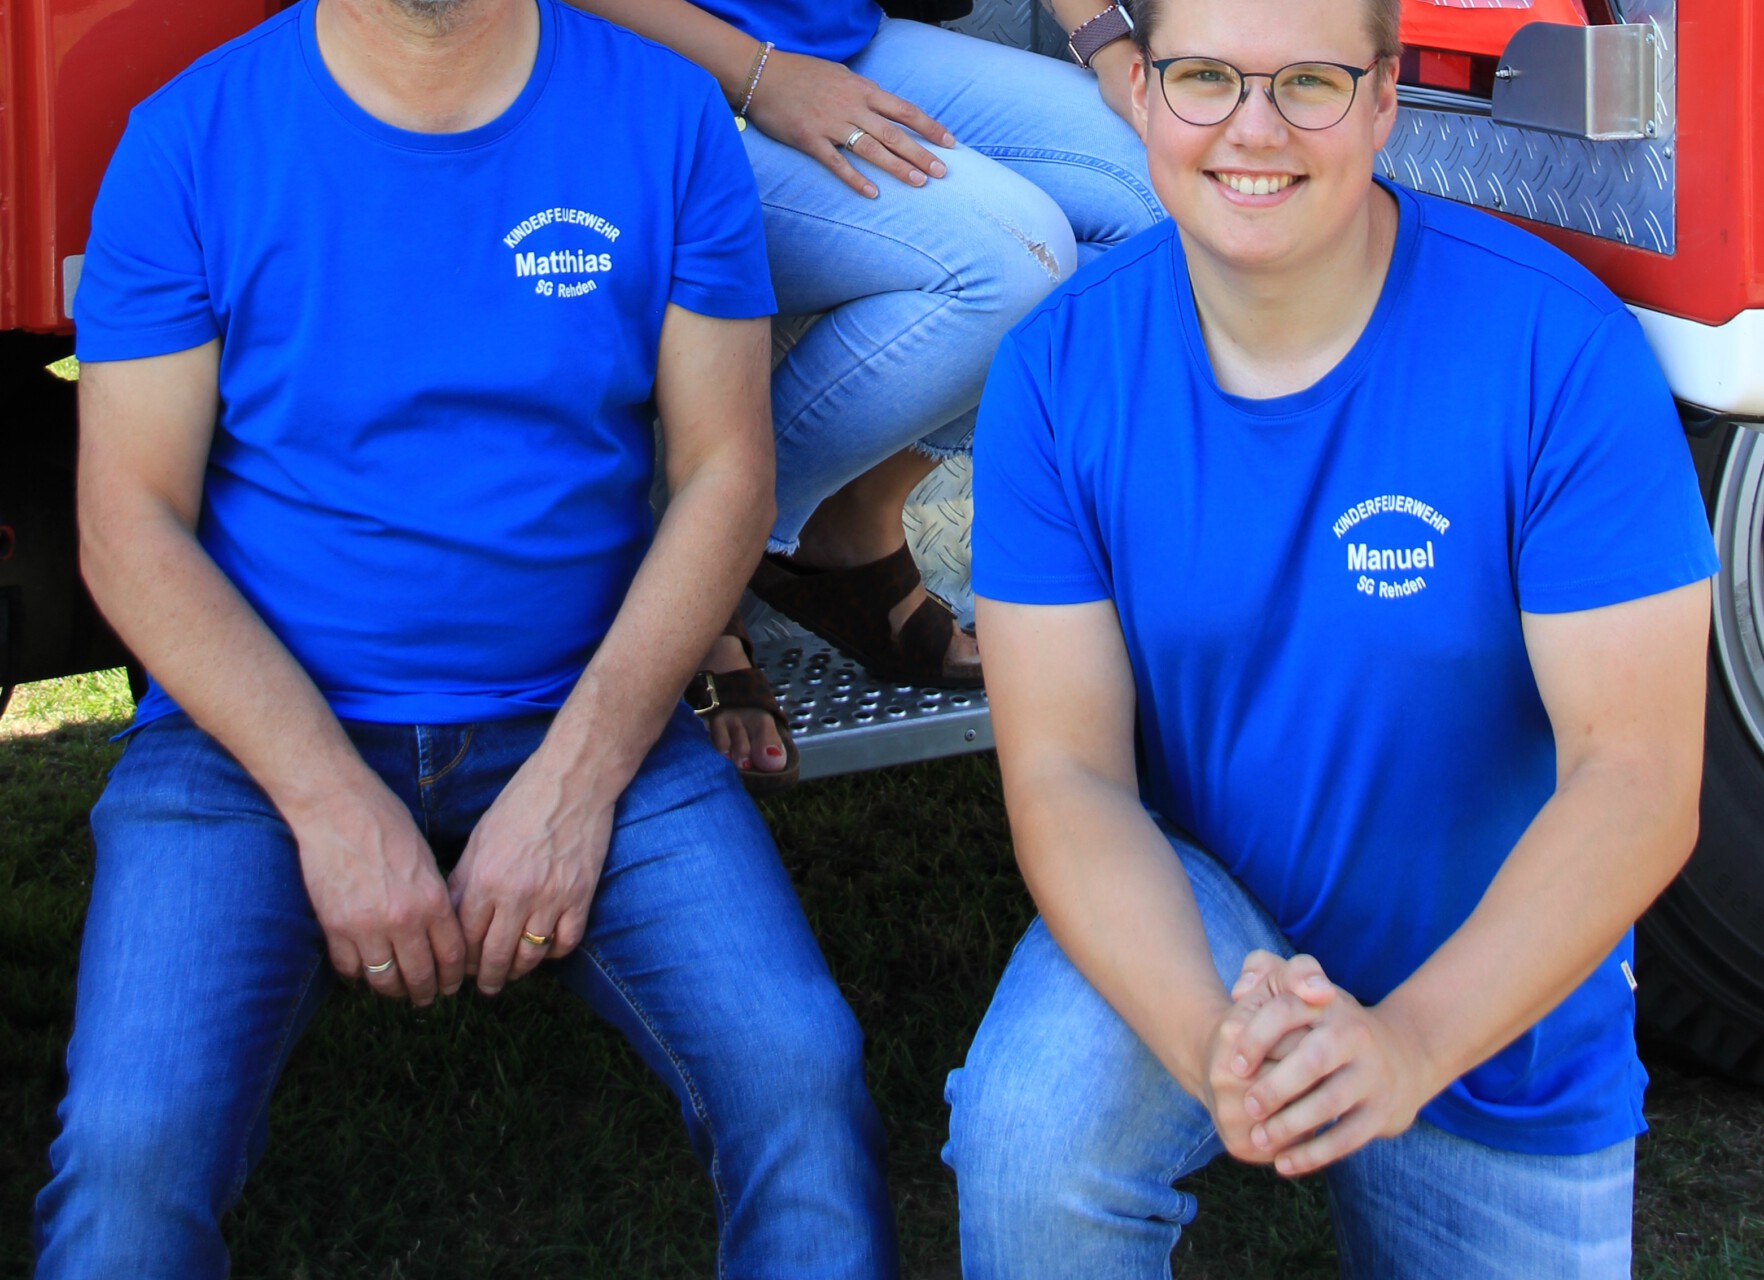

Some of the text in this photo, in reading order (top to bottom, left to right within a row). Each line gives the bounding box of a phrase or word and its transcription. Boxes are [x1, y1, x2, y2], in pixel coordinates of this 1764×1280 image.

[503, 207, 621, 249] KINDERFEUERWEHR
[515, 249, 612, 277] Matthias
[535, 279, 597, 298] SG Rehden
[1332, 495, 1451, 539] KINDERFEUERWEHR
[1347, 540, 1435, 571] Manuel
[1356, 575, 1426, 599] SG Rehden
